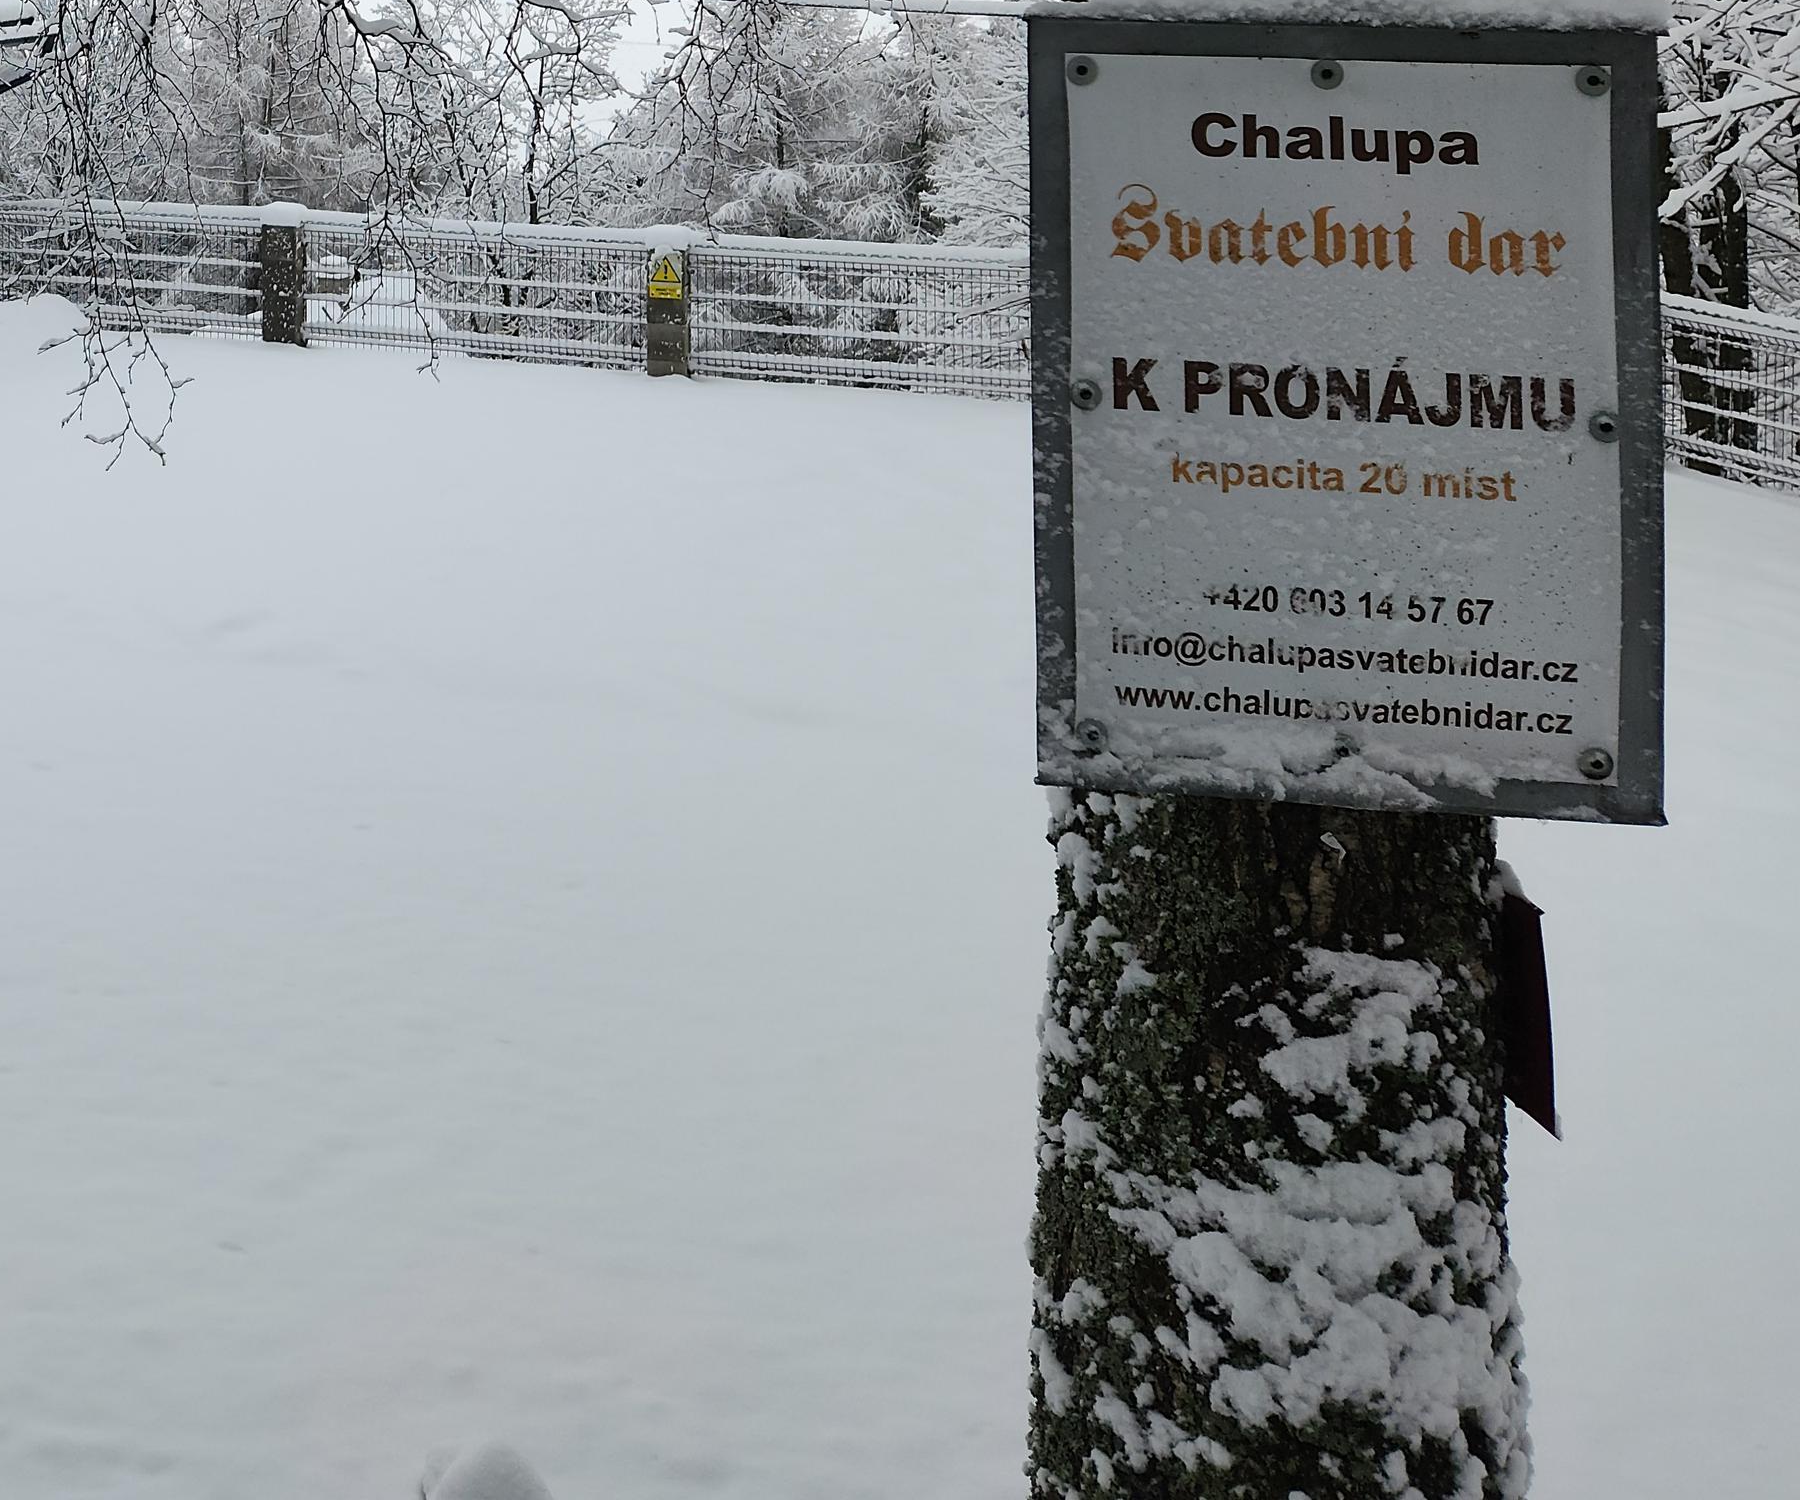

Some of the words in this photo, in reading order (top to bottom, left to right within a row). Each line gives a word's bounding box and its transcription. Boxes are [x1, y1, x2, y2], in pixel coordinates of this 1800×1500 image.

[1190, 112, 1479, 175] Chalupa
[1448, 211, 1567, 278] dar
[1112, 357, 1160, 412] K
[1183, 356, 1576, 432] PRONÁJMU
[1171, 454, 1345, 493] kapacita
[1359, 462, 1407, 495] 20
[1202, 583, 1279, 613] +420
[1358, 591, 1393, 620] 14
[1407, 595, 1447, 624] 57
[1457, 598, 1494, 626] 67
